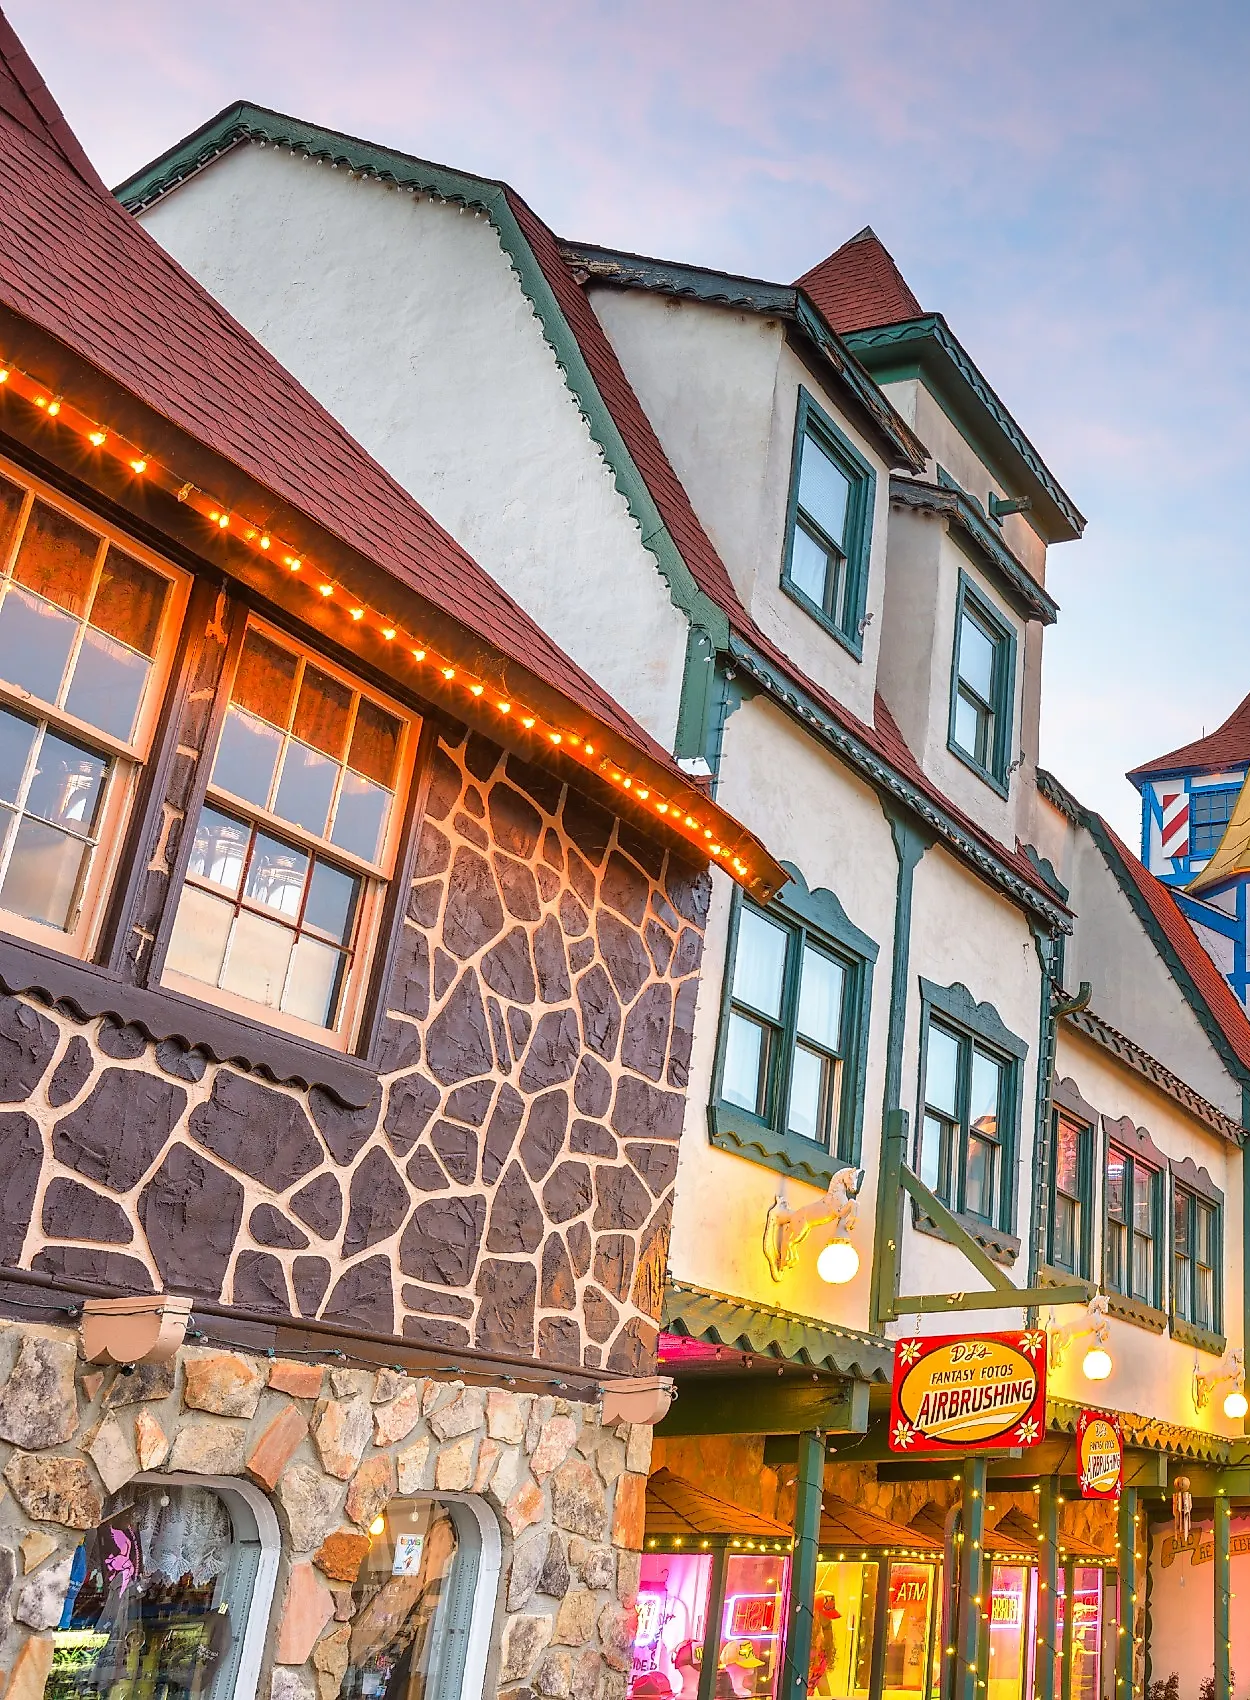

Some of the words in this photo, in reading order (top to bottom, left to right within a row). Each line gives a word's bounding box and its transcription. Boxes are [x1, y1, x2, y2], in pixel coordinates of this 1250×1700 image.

[951, 1343, 993, 1363] DJ's
[931, 1368, 976, 1386] FANTASY
[980, 1363, 1014, 1380] FOTOS
[913, 1378, 1035, 1431] AIRBRUSHING
[896, 1582, 927, 1602] ATM
